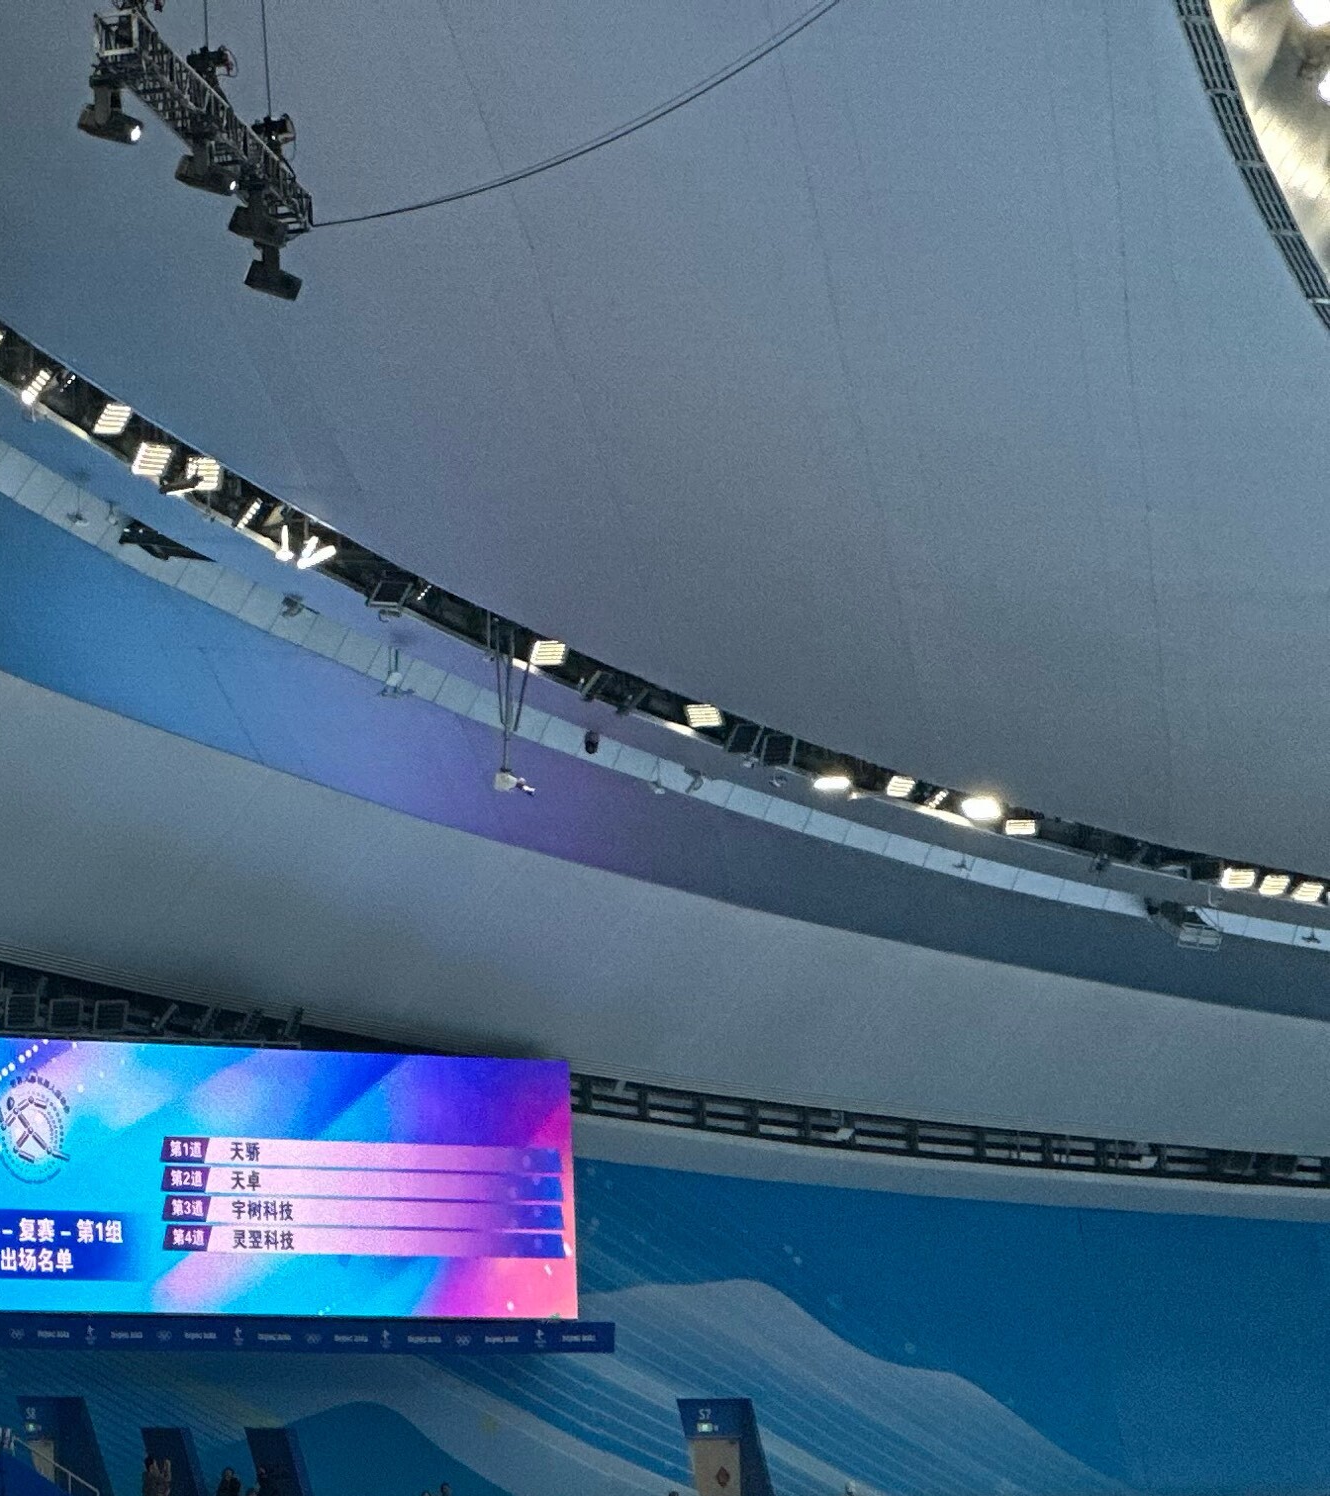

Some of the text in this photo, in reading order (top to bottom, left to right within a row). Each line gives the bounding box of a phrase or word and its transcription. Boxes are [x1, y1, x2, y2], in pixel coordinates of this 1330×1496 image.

[169, 1140, 202, 1158] 第1道
[170, 1169, 261, 1191] 第2道 天卓
[171, 1199, 293, 1221] 第3道 宇树科技
[18, 1217, 55, 1243] 复赛
[76, 1218, 123, 1244] 第1组
[172, 1228, 294, 1250] 第4道 灵翌科技
[0, 1247, 74, 1272] 出场名单
